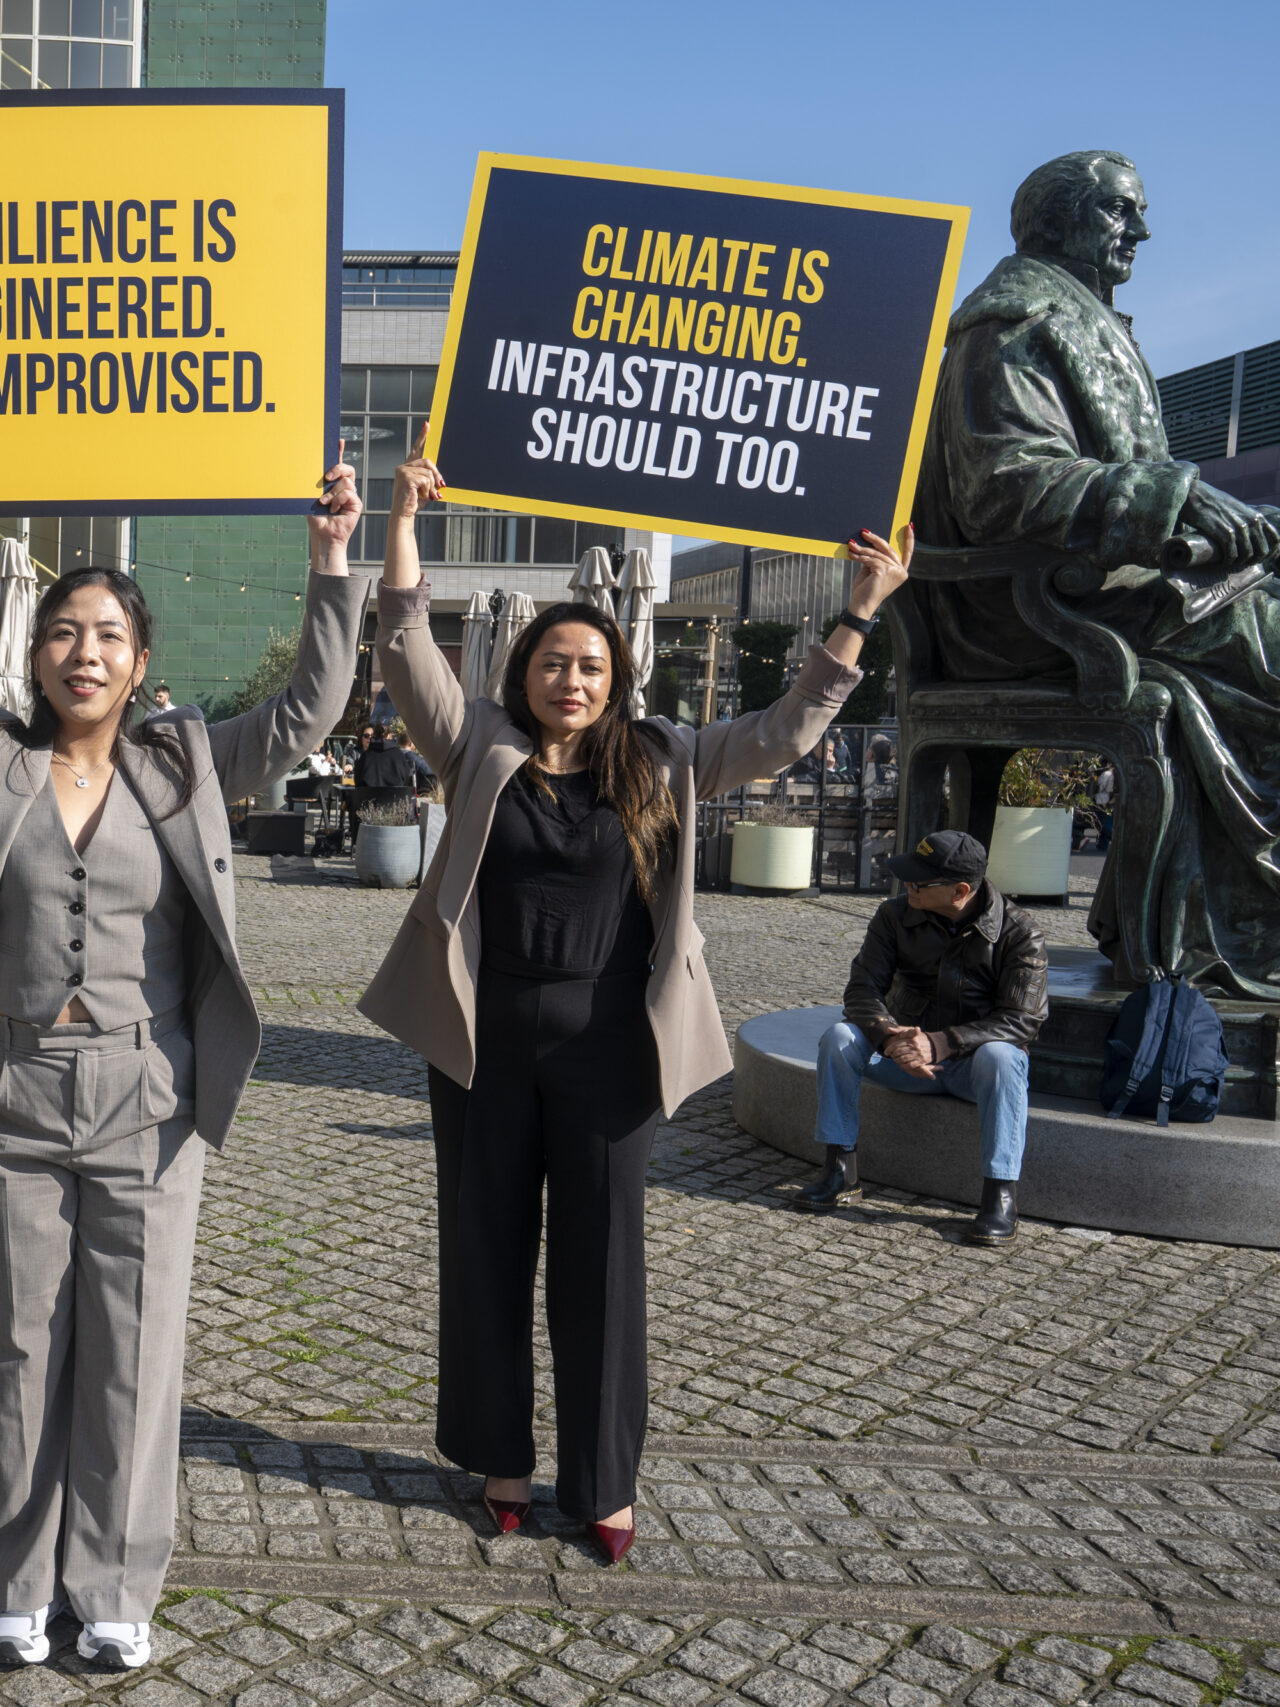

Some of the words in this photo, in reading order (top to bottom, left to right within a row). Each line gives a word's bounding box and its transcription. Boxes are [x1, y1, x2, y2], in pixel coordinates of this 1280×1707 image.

[193, 198, 236, 263] IS
[582, 223, 777, 298] CLIMATE
[782, 247, 830, 304] IS
[572, 286, 808, 368] CHANGING.
[487, 338, 880, 441] INFRASTRUCTURE
[526, 407, 702, 480] SHOULD
[715, 431, 806, 497] TOO.
